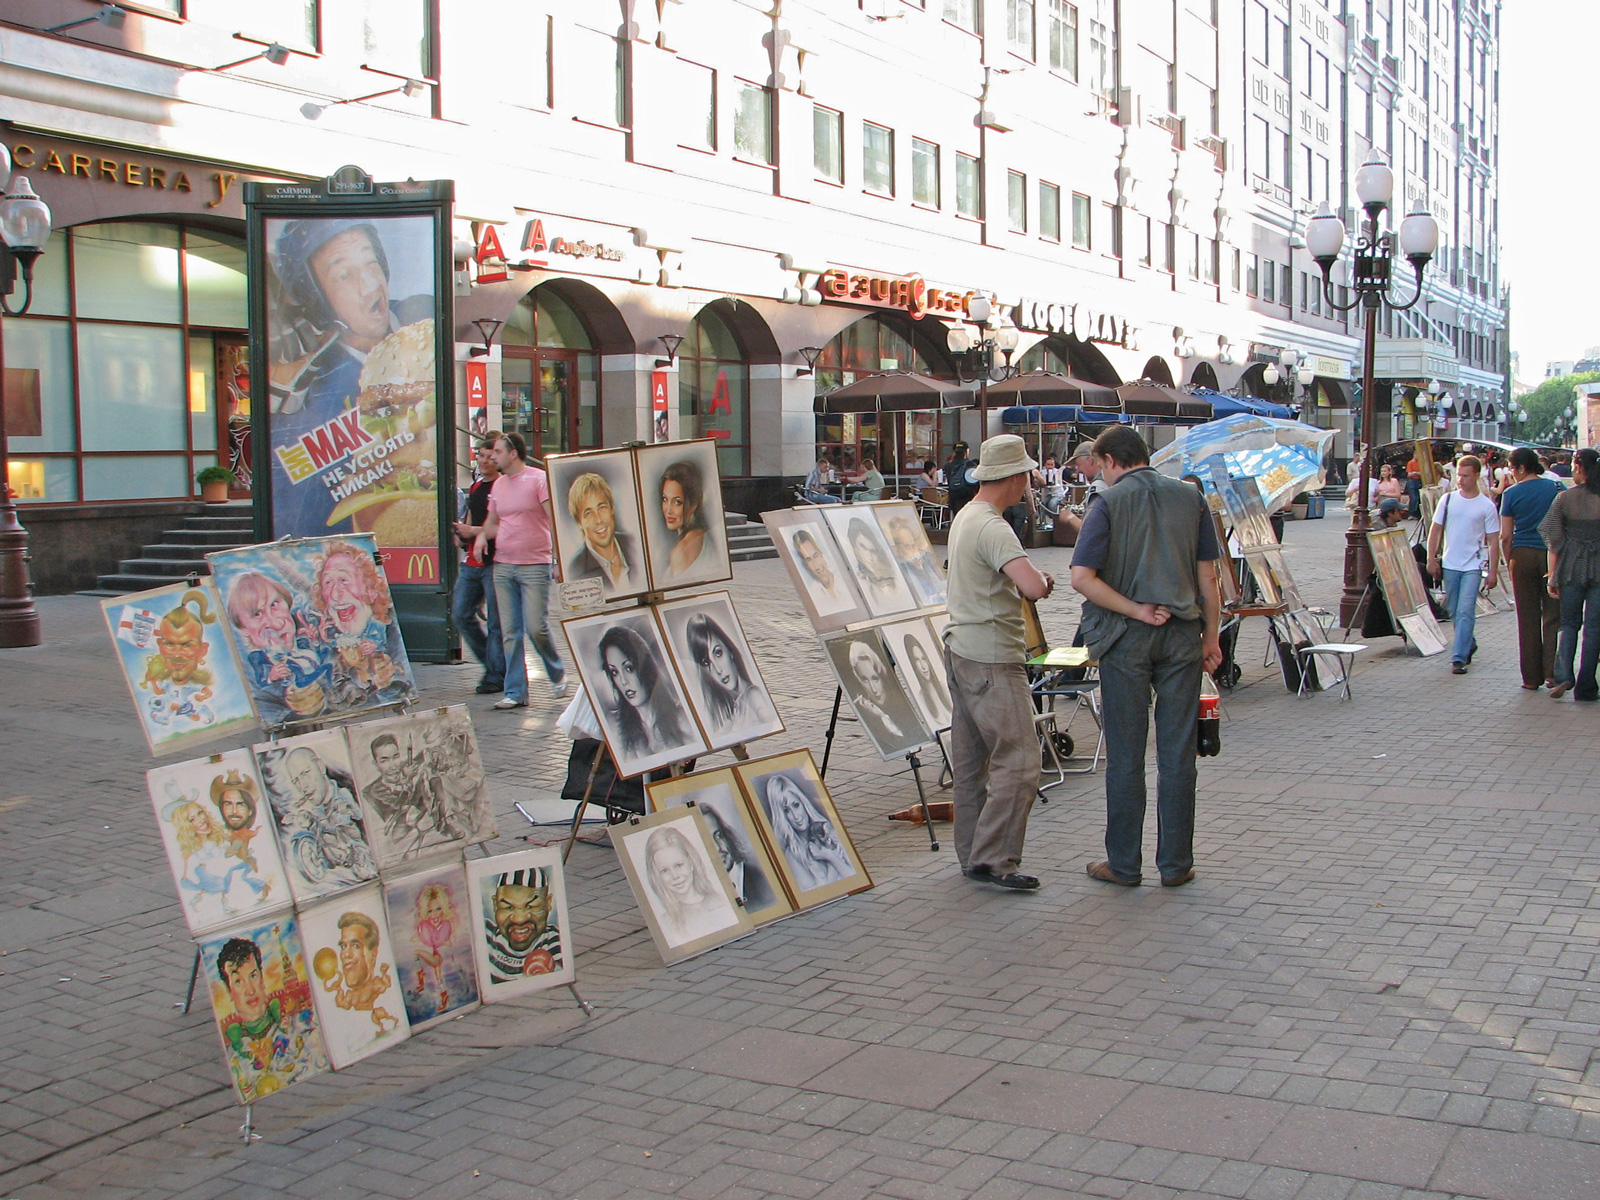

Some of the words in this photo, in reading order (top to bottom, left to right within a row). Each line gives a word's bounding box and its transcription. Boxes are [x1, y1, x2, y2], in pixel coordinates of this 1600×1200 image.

[12, 143, 193, 193] CARRERA
[276, 186, 312, 195] САЙМОН
[278, 445, 317, 481] БИГ
[301, 411, 373, 469] МАК
[322, 466, 347, 488] НЕ
[345, 431, 415, 474] УСТОЯТЬ
[329, 459, 395, 503] НИКАК!
